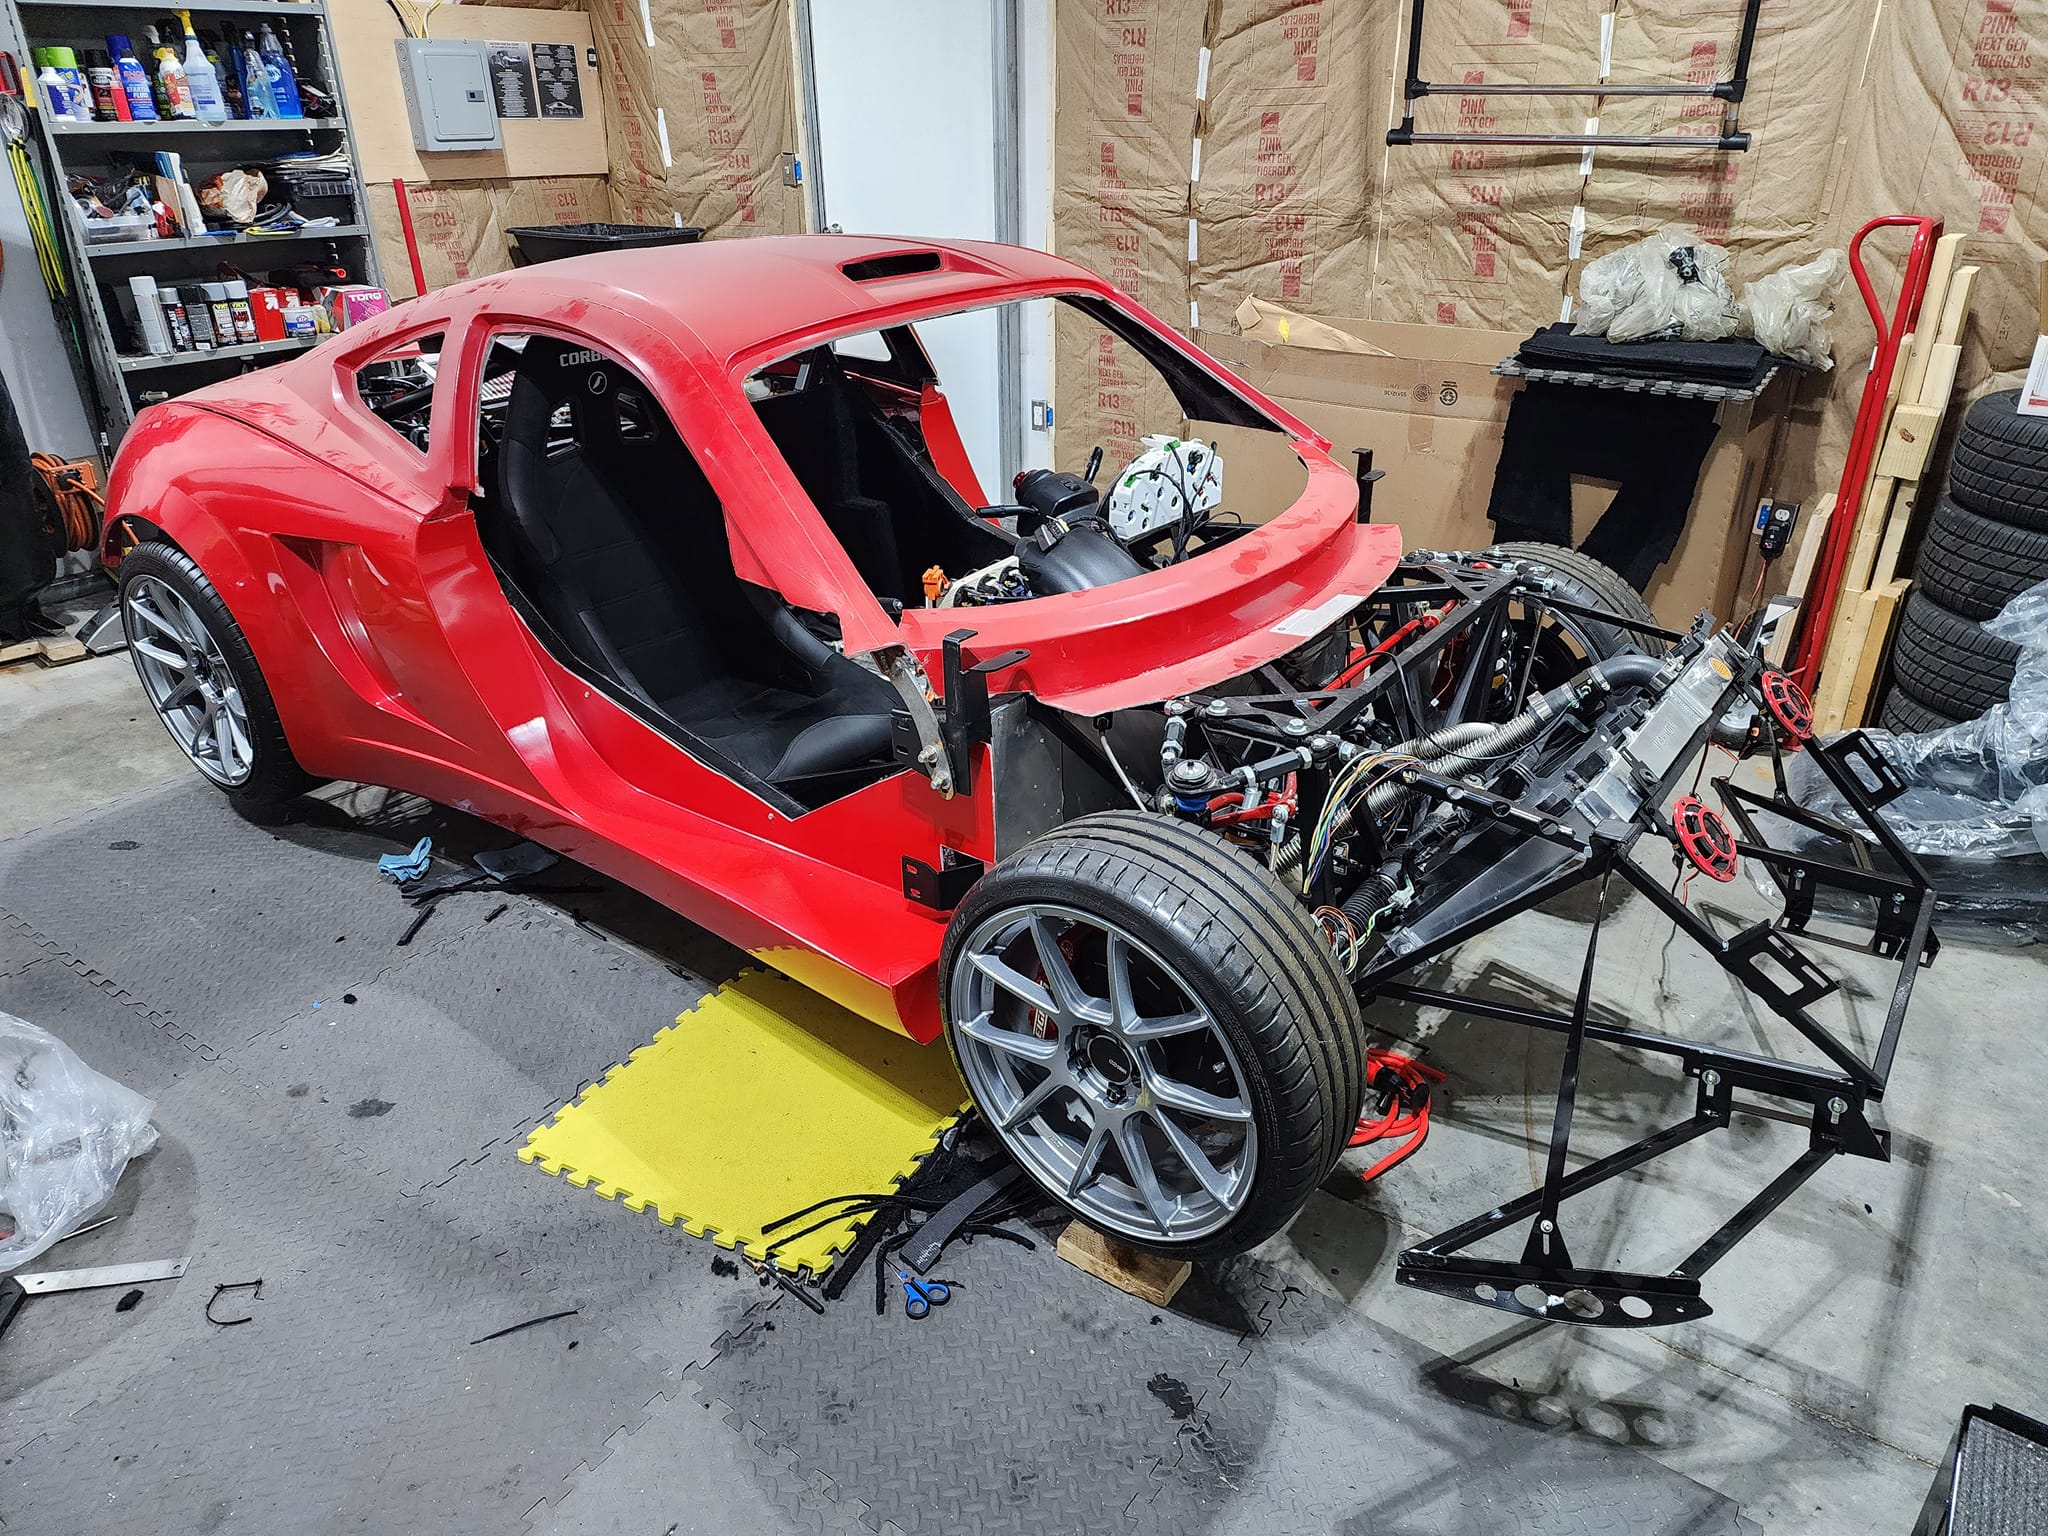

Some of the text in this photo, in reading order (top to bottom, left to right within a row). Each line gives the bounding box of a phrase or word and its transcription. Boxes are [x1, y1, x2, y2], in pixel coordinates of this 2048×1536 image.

[1106, 0, 1131, 15] R13
[715, 15, 734, 28] PINK
[1280, 12, 1321, 26] FIBERGLAS
[1979, 15, 2019, 34] PINK
[1122, 28, 1147, 48] R13
[1282, 26, 1320, 40] NEXT GEN
[1293, 40, 1318, 56] PINK
[1975, 36, 2029, 52] NEXT GEN
[1112, 53, 1145, 65] FIBERGLAS
[1972, 53, 2032, 69] FIBERGLAS
[1117, 66, 1144, 77] NEXT GEN
[1125, 79, 1144, 92] PINK
[1962, 76, 2012, 102] R13
[704, 92, 722, 104] PINK
[705, 105, 719, 114] NEXT
[1460, 98, 1486, 115] PINK
[1680, 103, 1729, 118] FIBERGLA
[1457, 116, 1496, 128] NEXT GEN
[708, 128, 732, 144] R13
[1984, 121, 2034, 147] R13
[1258, 137, 1283, 152] PINK
[727, 154, 750, 169] R13
[1257, 152, 1293, 163] NEXT GEN
[1451, 149, 1485, 170] R13
[1966, 152, 2024, 170] FIBERGLAS
[1100, 164, 1118, 178] PINK
[1256, 165, 1297, 177] FIBERGLAS
[1992, 169, 2020, 185] NEXT
[1254, 182, 1285, 201] R13
[1470, 185, 1503, 207] R13
[1680, 192, 1733, 205] FIBERGLAS
[1980, 184, 2017, 204] PINK
[557, 192, 577, 207] R13
[433, 211, 456, 227] R13
[1099, 206, 1121, 222] R13
[1684, 206, 1732, 218] NEXT GEN
[1274, 214, 1305, 231] R13
[1116, 235, 1140, 252] R13
[1264, 238, 1304, 249] FIBERGLAS
[1472, 237, 1497, 252] PINK
[447, 250, 466, 261] PINK
[1269, 249, 1303, 260] NEXT GEN
[1279, 260, 1302, 274] PINK
[1120, 279, 1139, 293] PINK
[348, 292, 382, 302] TORQ
[560, 350, 609, 367] CORB
[1098, 354, 1117, 367] PINK
[1098, 367, 1124, 379] NEXT GEN
[1098, 378, 1129, 389] FIBERGLAS
[1098, 392, 1120, 408] R13
[1113, 420, 1136, 437] R13
